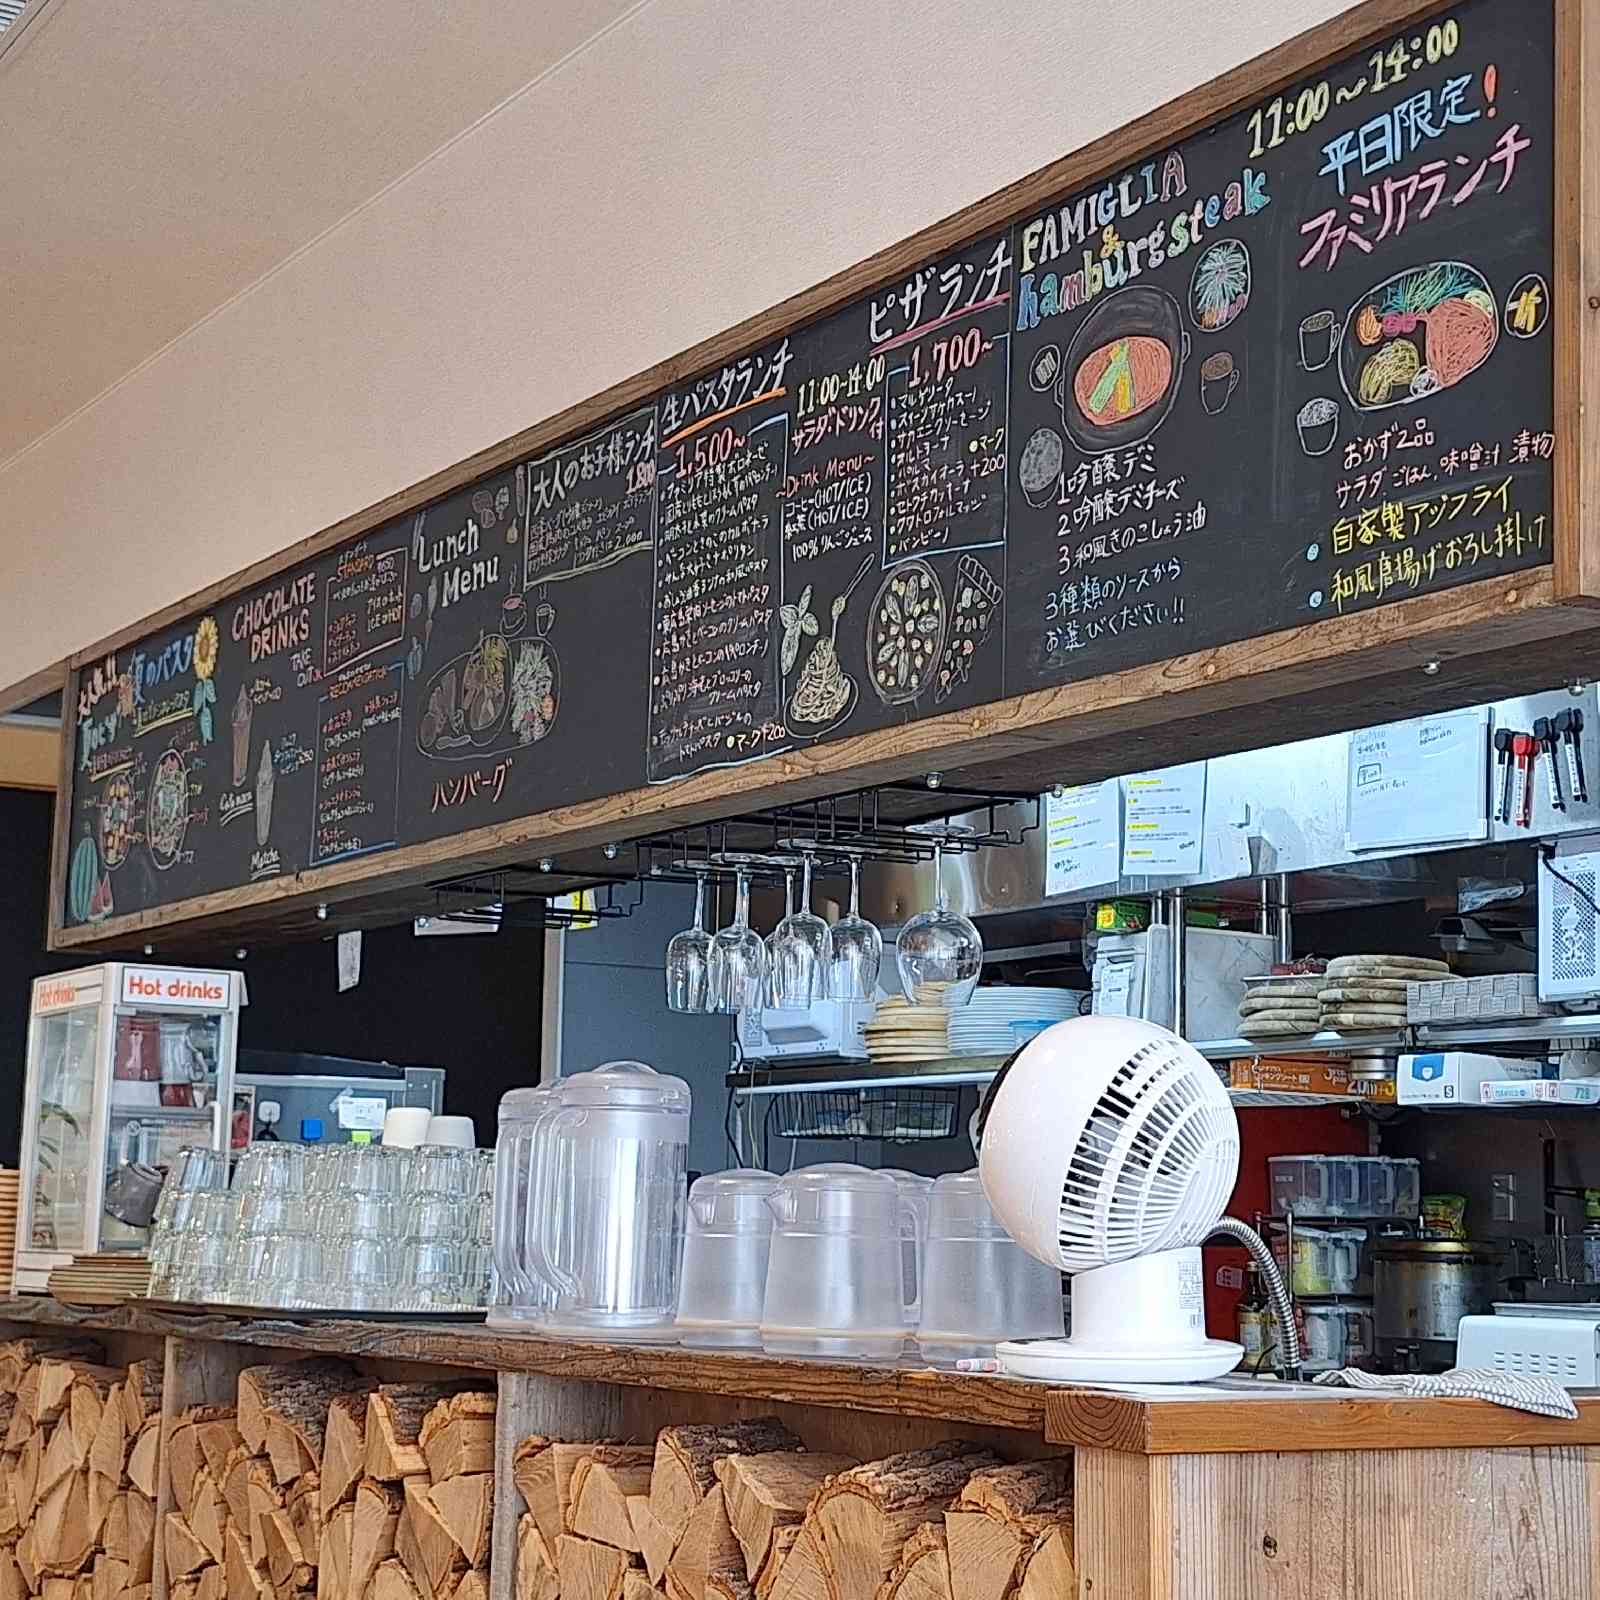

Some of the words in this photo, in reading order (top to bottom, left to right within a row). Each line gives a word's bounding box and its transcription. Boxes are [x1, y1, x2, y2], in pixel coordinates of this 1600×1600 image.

[1019, 150, 1188, 272] FAMIGLIA
[1300, 122, 1531, 271] ファミリアランチ
[868, 237, 1013, 344] ピザランチ
[660, 337, 794, 436] 生パスタランチ
[533, 418, 655, 516] 大人のお子様ランチ
[1343, 418, 1435, 470] おかず2品
[418, 519, 480, 573] Lunch
[231, 572, 316, 642] CHOCOLATE
[441, 555, 500, 608] Menu
[251, 608, 310, 663] DRINKS
[129, 975, 161, 996] Hot
[168, 979, 223, 1000] drinks
